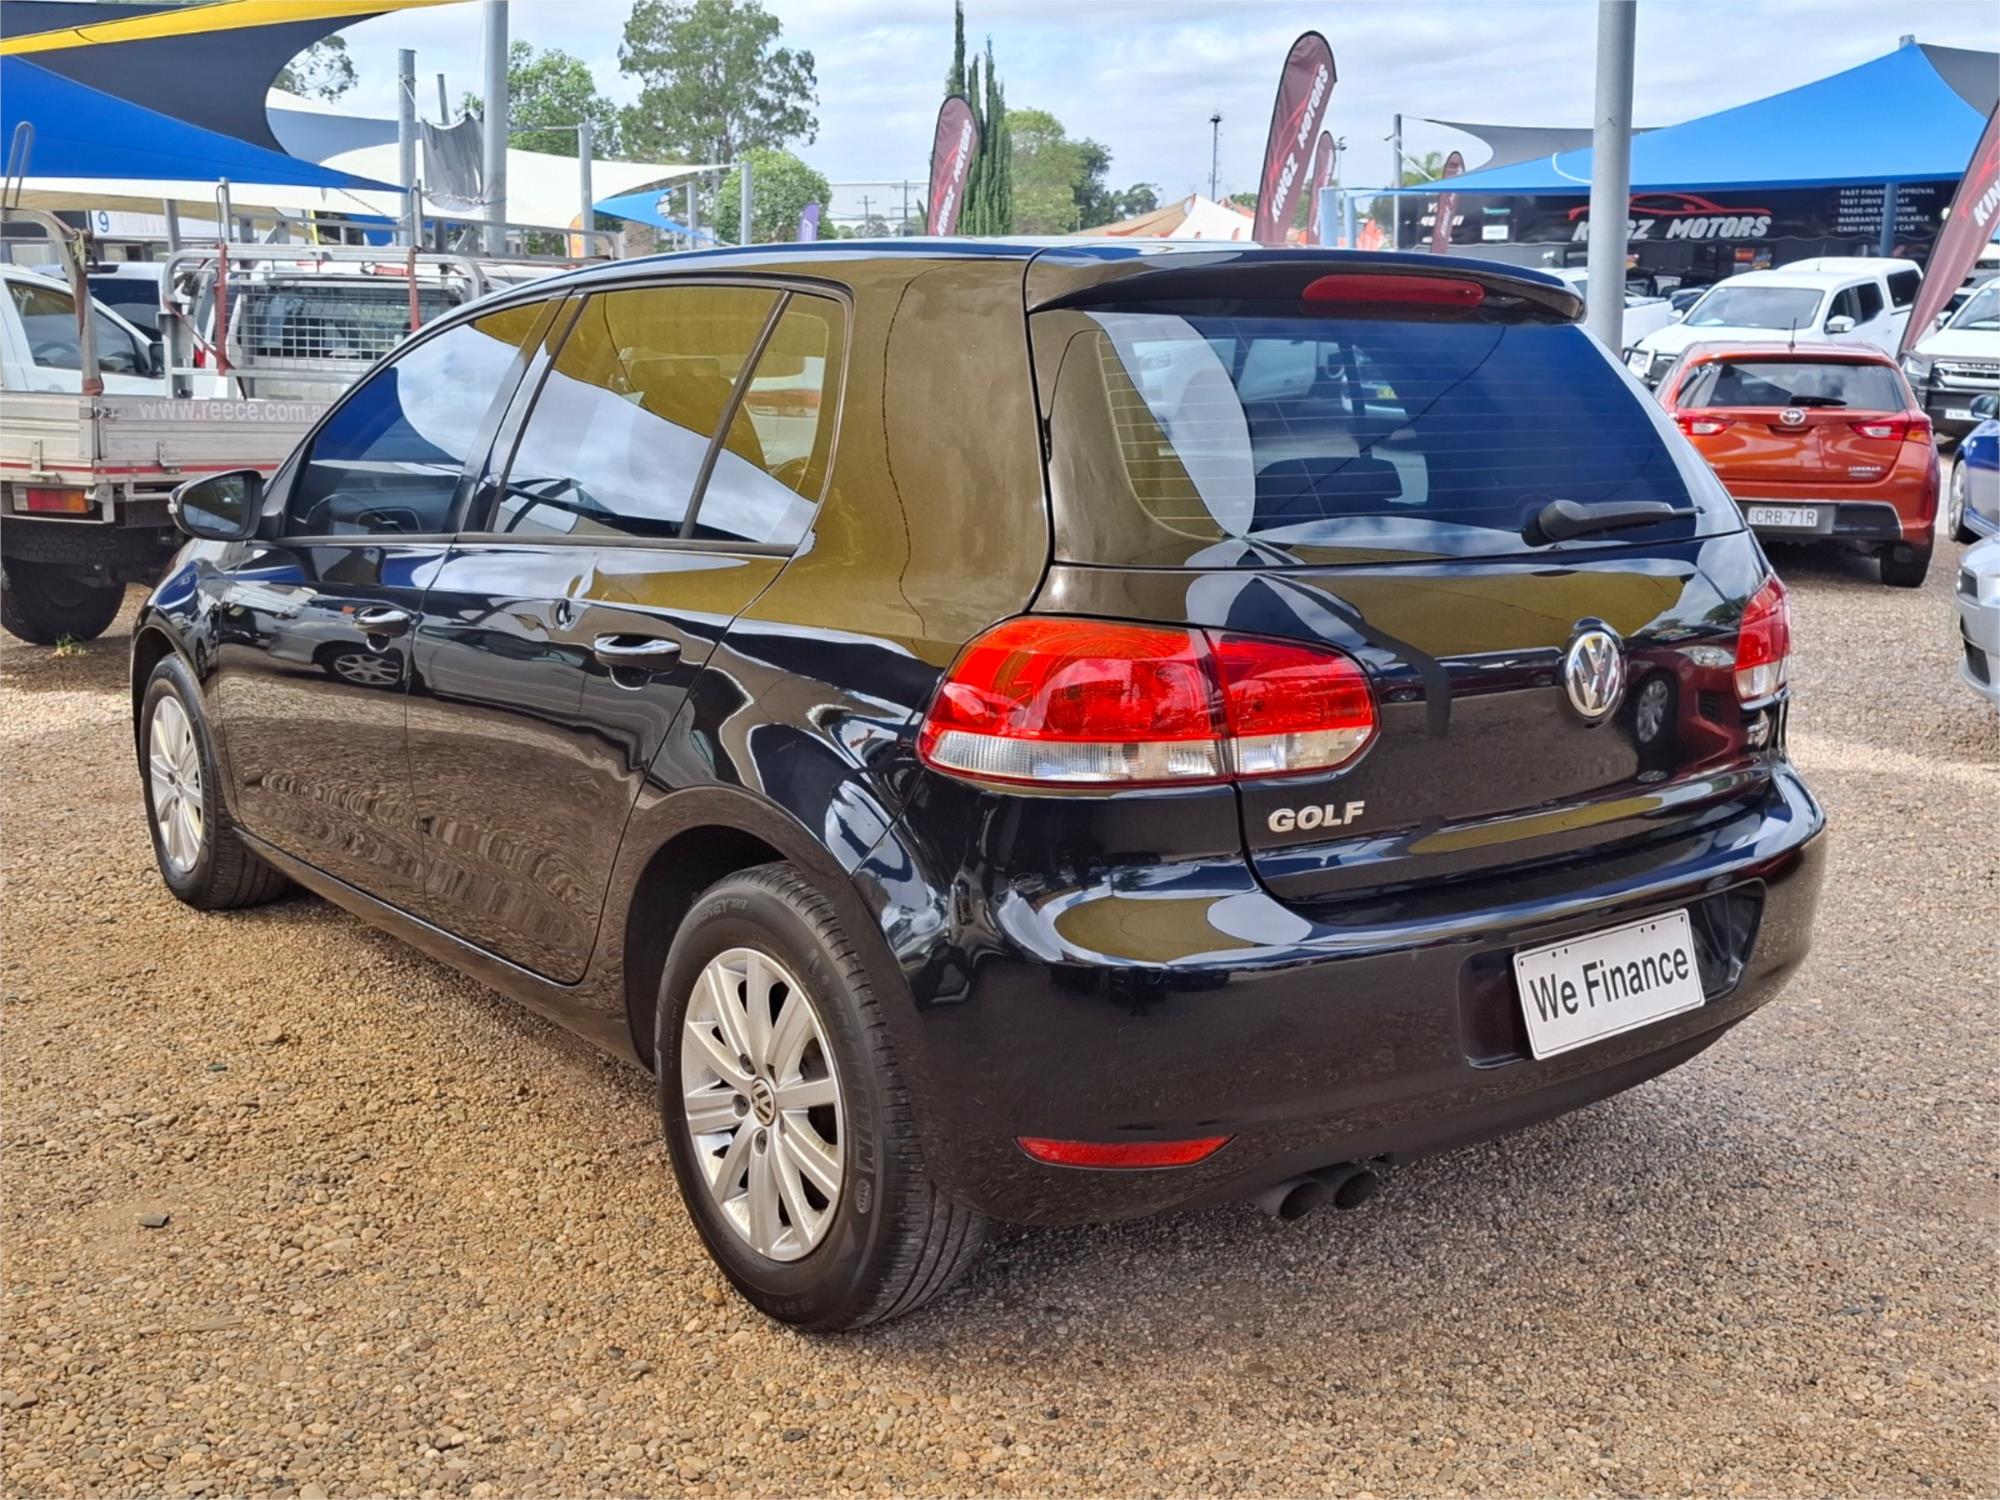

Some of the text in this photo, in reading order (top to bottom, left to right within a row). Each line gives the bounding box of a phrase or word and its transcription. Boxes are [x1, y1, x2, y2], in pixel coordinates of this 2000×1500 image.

[1271, 152, 1298, 223] KINGZ
[1297, 63, 1329, 149] MOTORS
[98, 211, 109, 233] 9
[1572, 216, 1772, 242] KGZ MOTORS
[1268, 801, 1365, 832] GOLF
[1529, 947, 1689, 1022] We Finance
